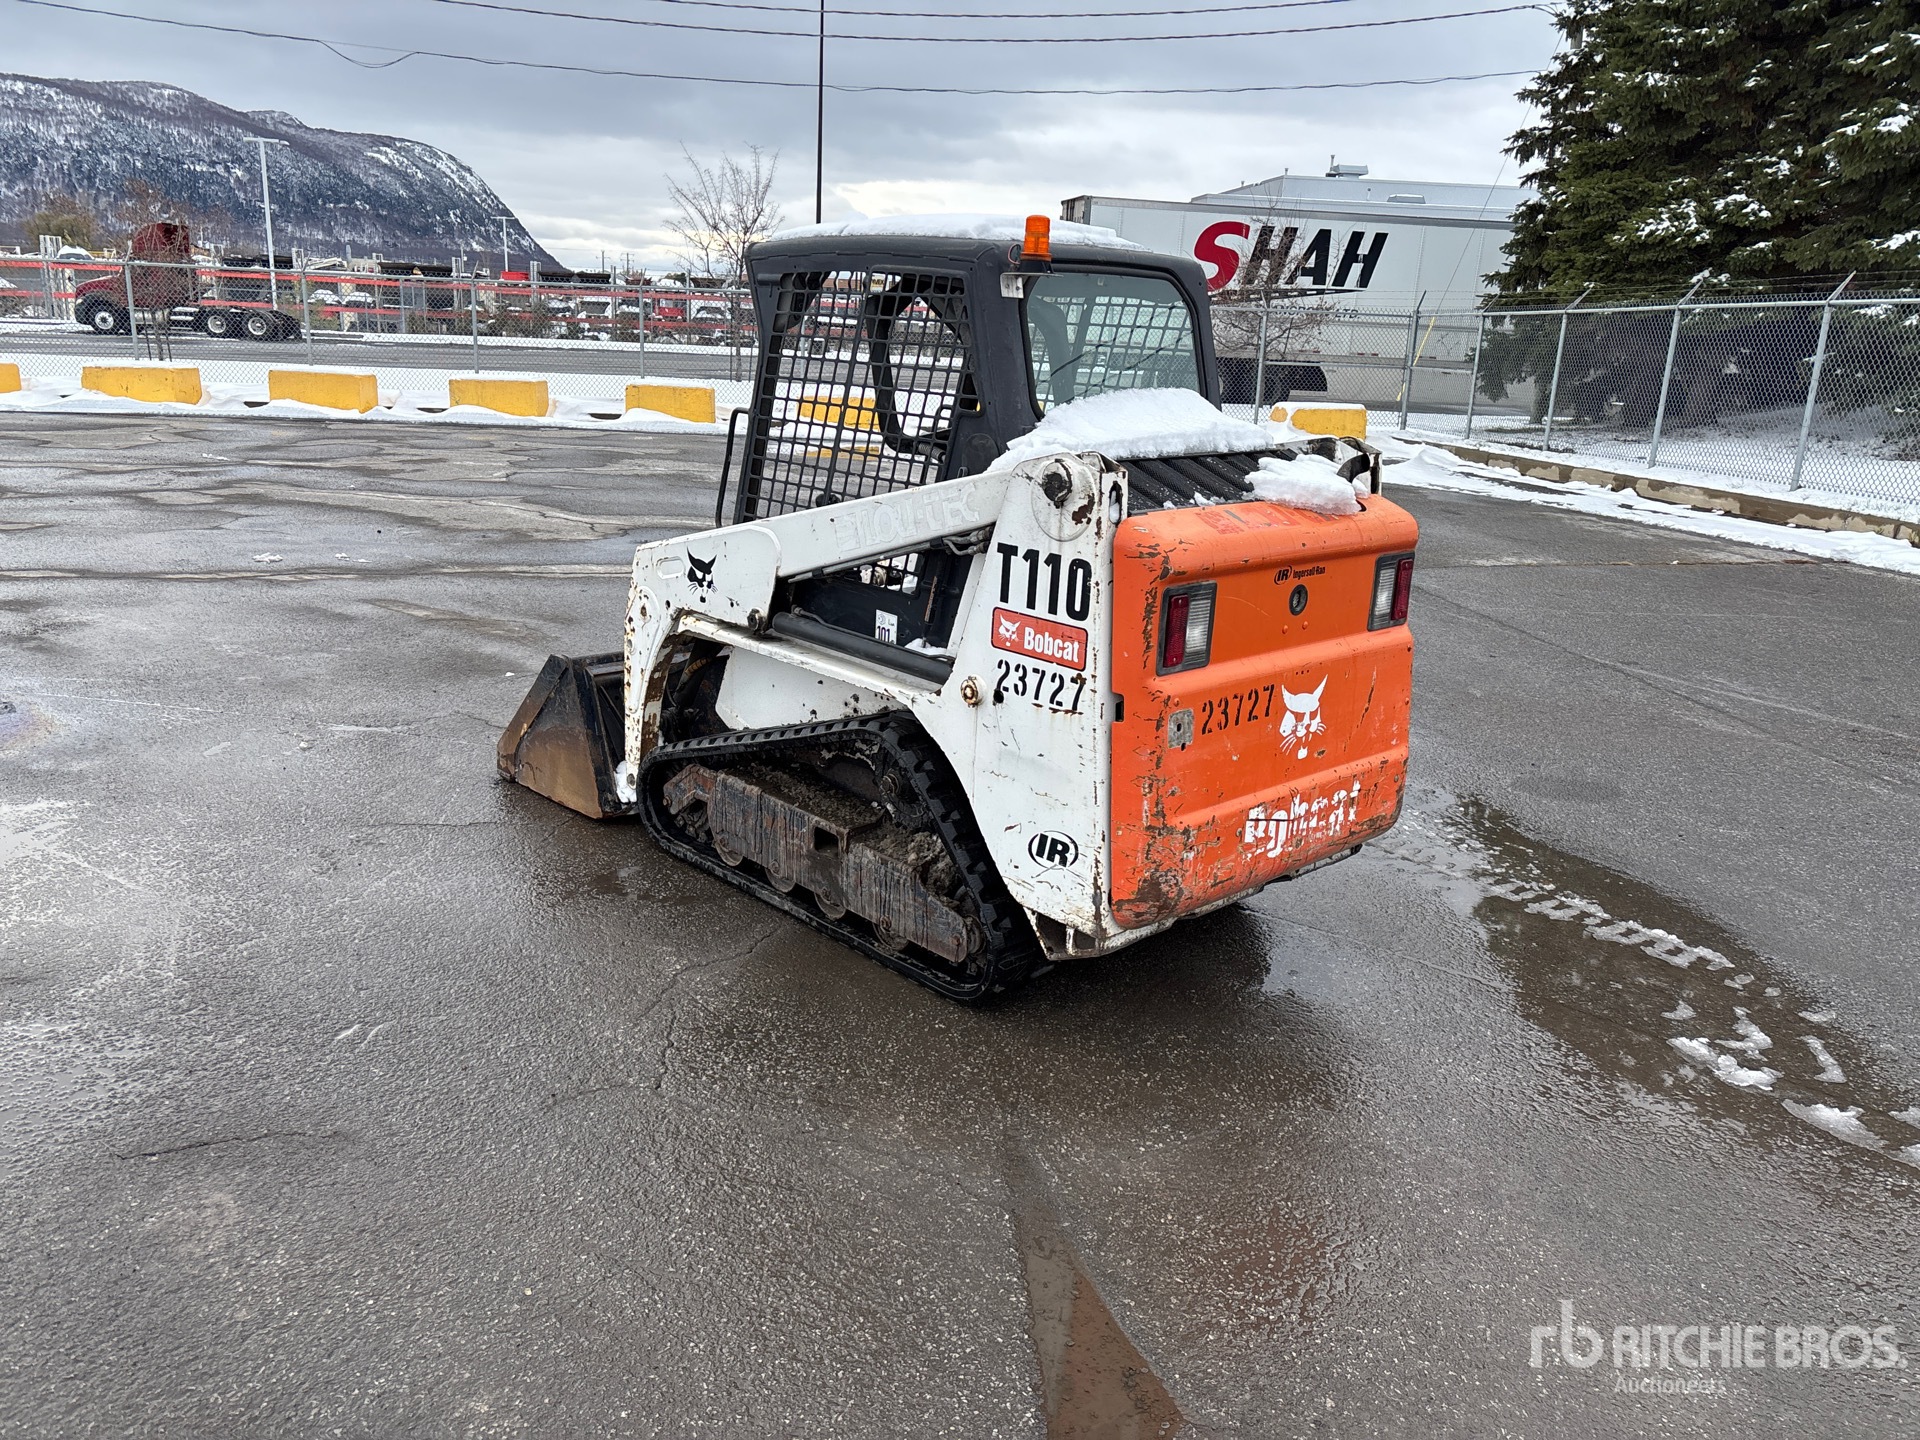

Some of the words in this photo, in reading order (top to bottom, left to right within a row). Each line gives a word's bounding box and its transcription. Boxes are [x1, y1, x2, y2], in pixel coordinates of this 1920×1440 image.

[1194, 220, 1389, 291] SHAH
[996, 541, 1092, 622] T110
[1023, 626, 1080, 663] Bobcat
[996, 658, 1088, 712] 23727
[1201, 683, 1275, 736] 23727
[1035, 833, 1072, 868] IR
